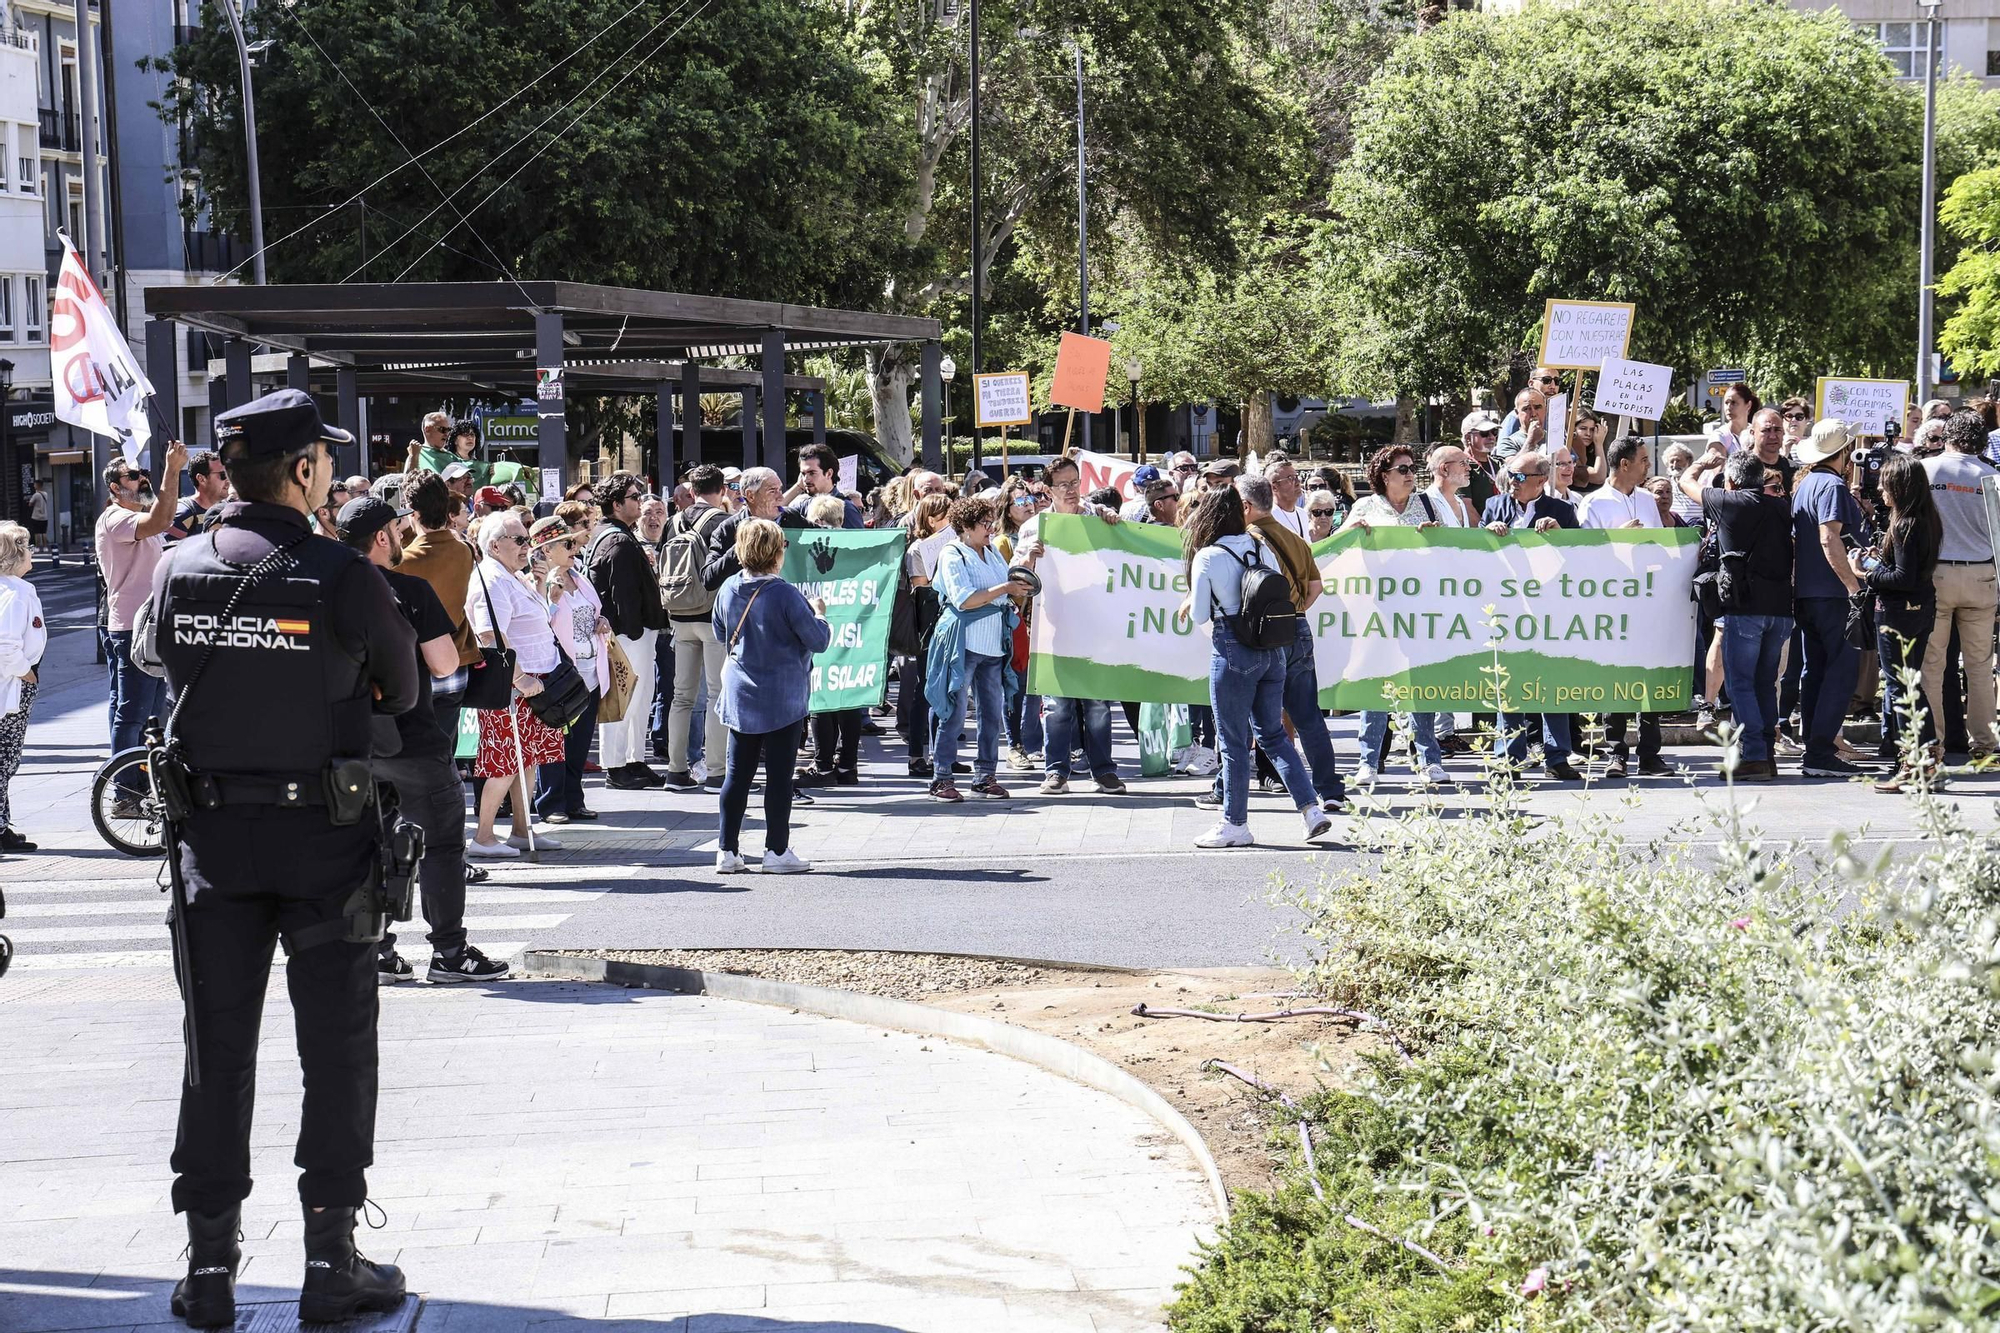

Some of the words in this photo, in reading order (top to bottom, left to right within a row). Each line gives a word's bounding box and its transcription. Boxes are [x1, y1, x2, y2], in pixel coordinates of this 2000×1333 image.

[1553, 310, 1572, 324] NO
[1551, 329, 1574, 341] CON
[1623, 367, 1644, 377] LAS
[982, 380, 990, 388] SI
[1613, 379, 1653, 393] PLACAS
[1849, 387, 1868, 396] CON
[1873, 388, 1892, 398] MIS
[1605, 400, 1654, 415] AUTOPISTA
[1848, 409, 1861, 417] NO
[33, 412, 54, 425] SOCIETY
[1106, 563, 1187, 593] ¡Nue
[1322, 575, 1421, 601] ampo
[1440, 577, 1482, 598] no
[1500, 578, 1541, 599] se
[1559, 571, 1654, 598] toca!
[1317, 612, 1472, 640] PLANTA
[1490, 613, 1629, 641] SOLAR!
[174, 630, 311, 650] NACIONAL
[827, 663, 877, 691] SOLAR
[1555, 685, 1605, 706] pero
[1613, 681, 1647, 700] NO
[1654, 679, 1682, 699] así
